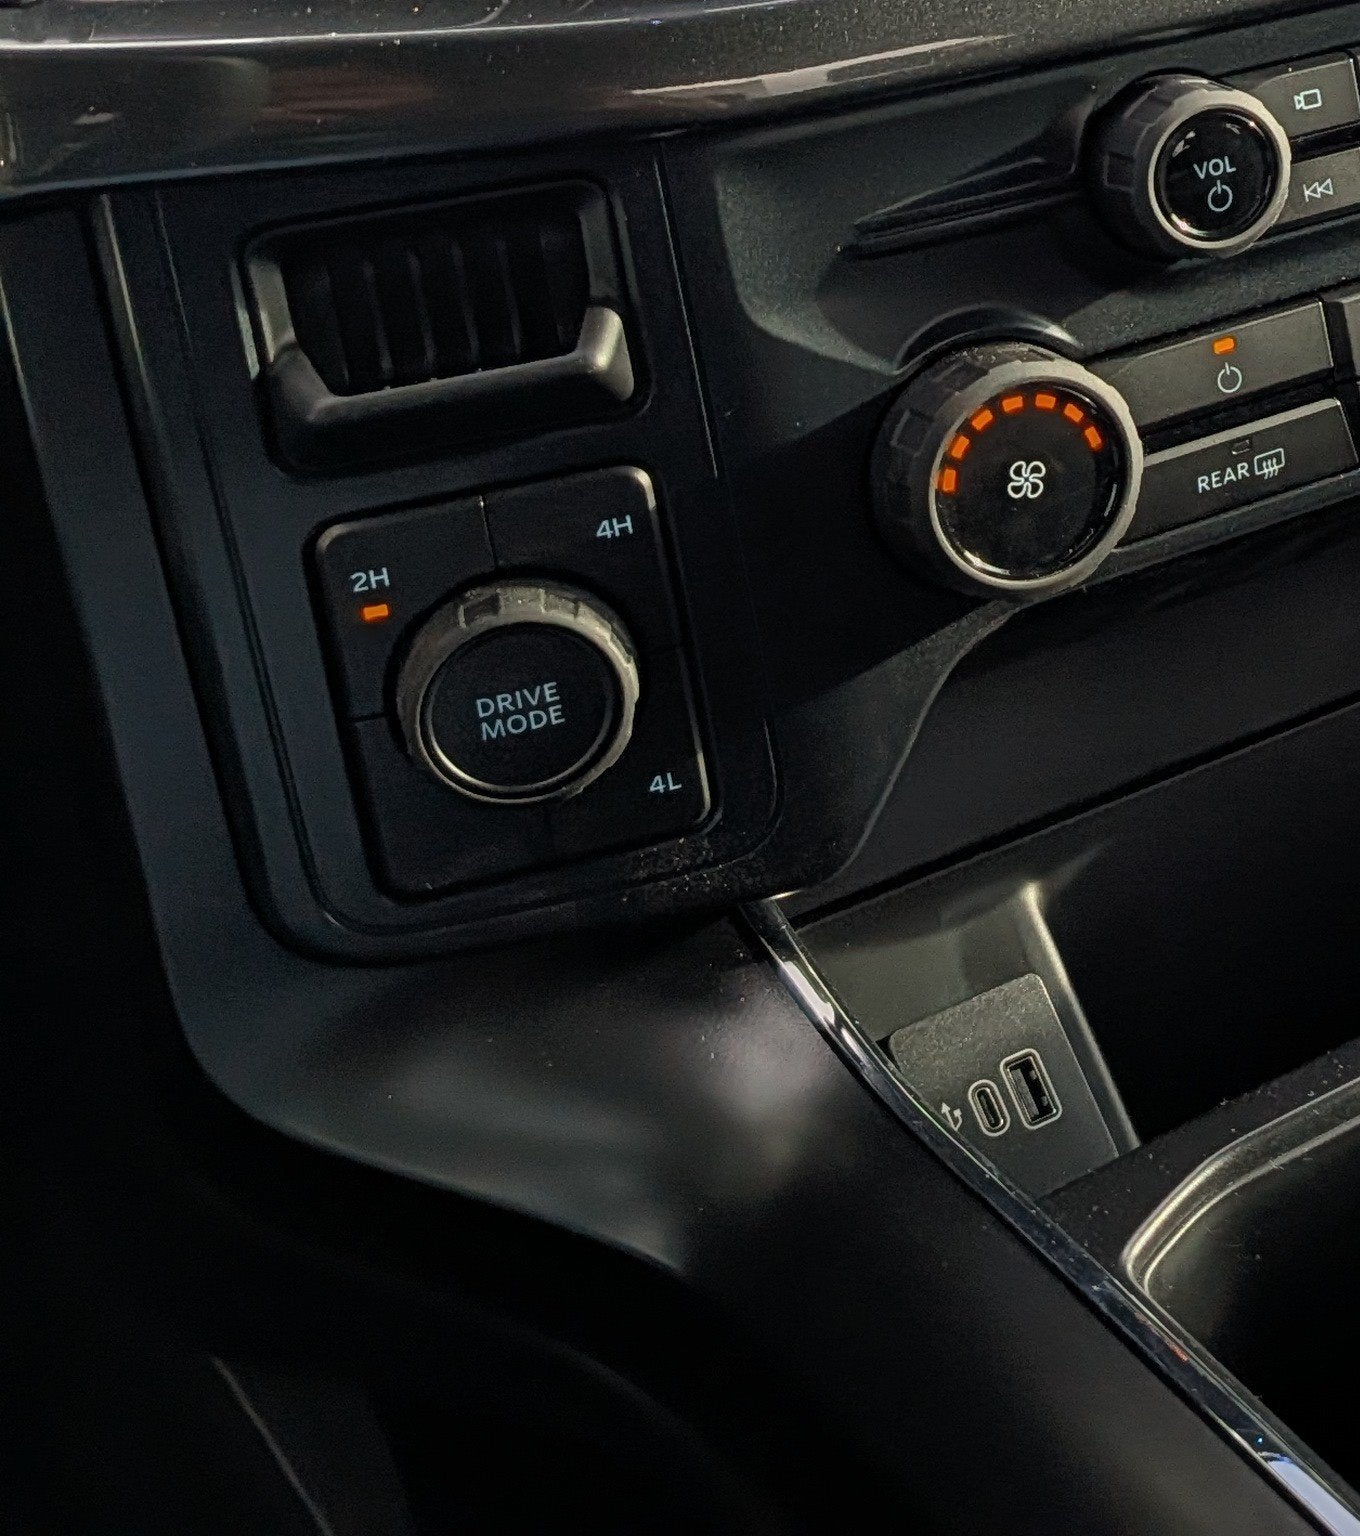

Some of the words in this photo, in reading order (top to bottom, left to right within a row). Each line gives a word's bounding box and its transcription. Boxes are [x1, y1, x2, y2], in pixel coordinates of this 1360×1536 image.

[1192, 155, 1237, 180] VOL
[1197, 461, 1251, 494] REAR
[595, 514, 634, 539] 4H
[349, 567, 391, 593] 2H
[475, 680, 561, 719] DRIVE
[480, 704, 566, 741] MODE
[648, 772, 683, 795] 4L
